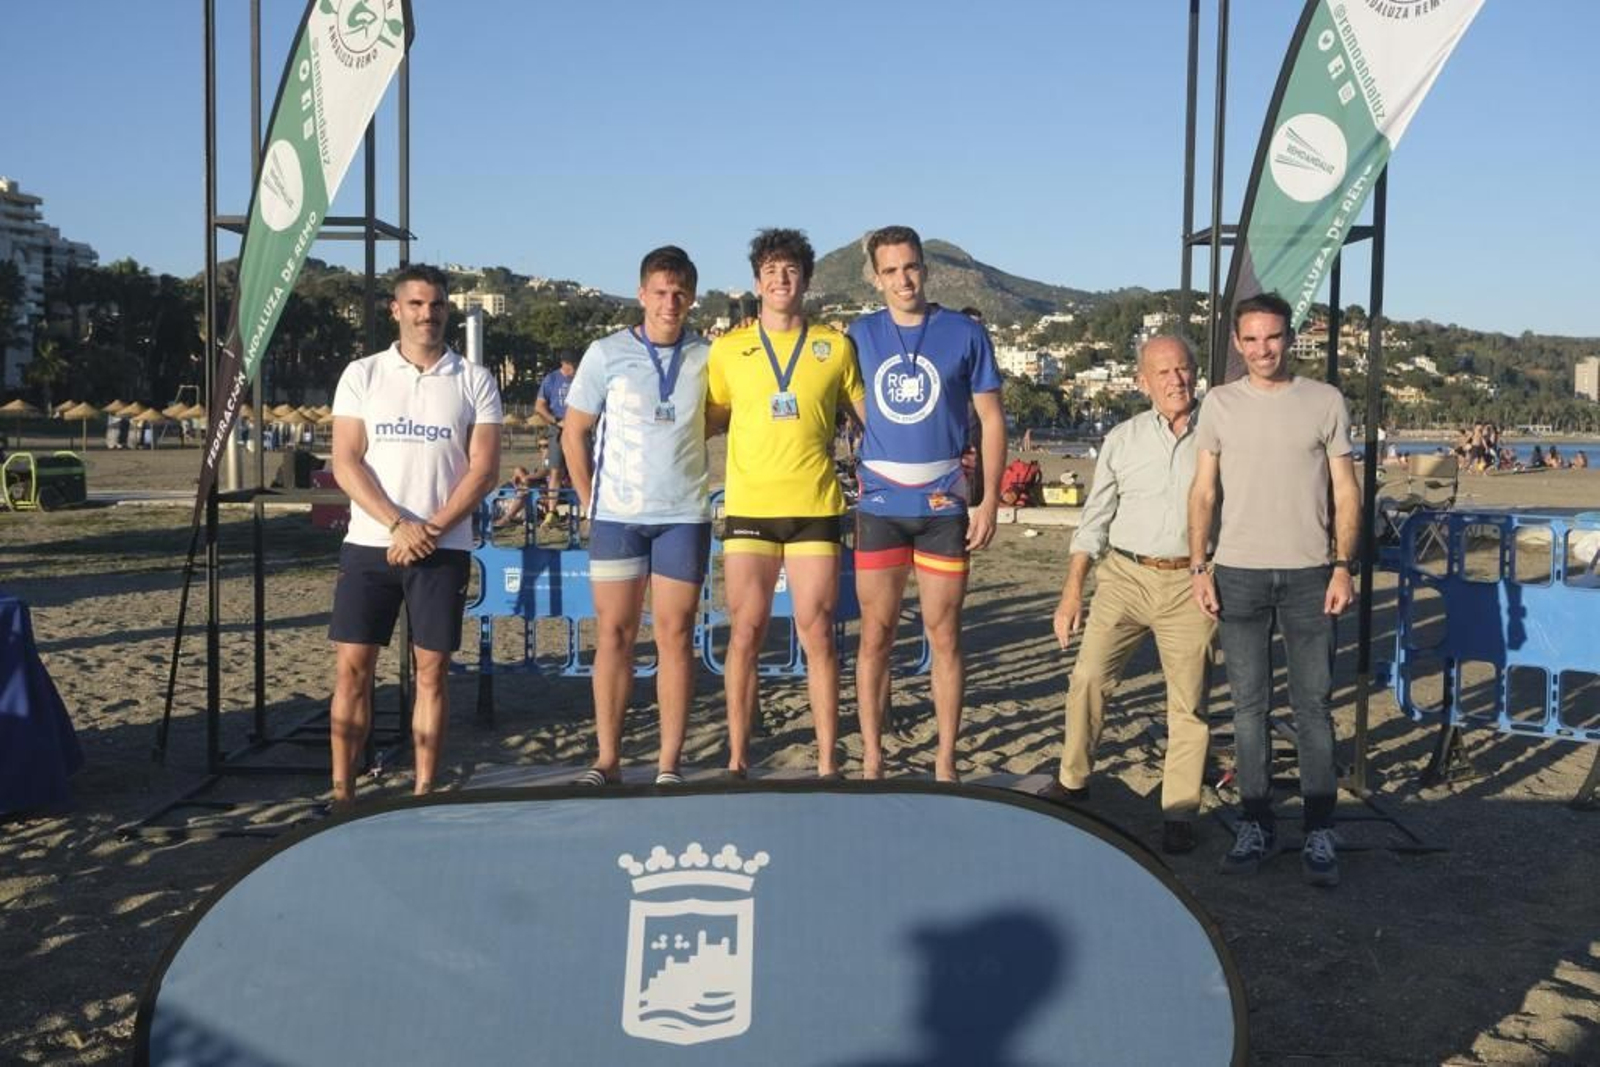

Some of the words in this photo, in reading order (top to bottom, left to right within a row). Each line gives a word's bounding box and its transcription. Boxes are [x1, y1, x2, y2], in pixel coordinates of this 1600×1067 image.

[1327, 216, 1345, 239] DE
[245, 286, 284, 366] ANDALUZA
[281, 260, 296, 281] DE
[295, 212, 317, 255] REMO
